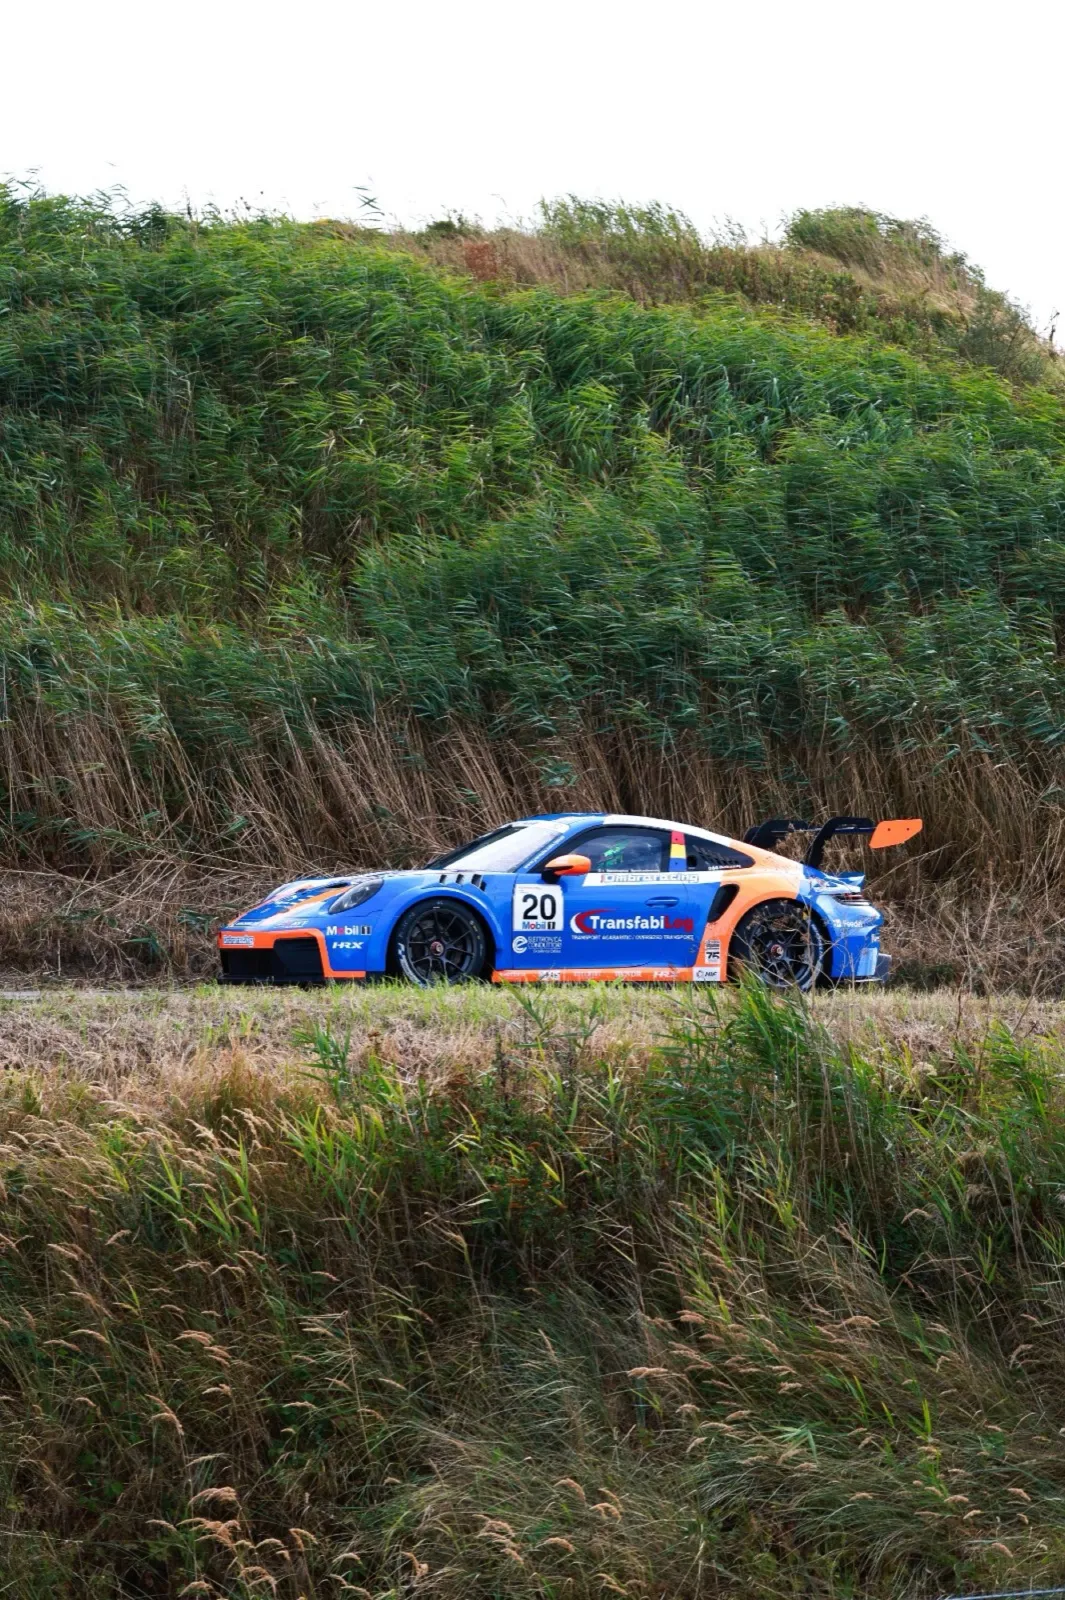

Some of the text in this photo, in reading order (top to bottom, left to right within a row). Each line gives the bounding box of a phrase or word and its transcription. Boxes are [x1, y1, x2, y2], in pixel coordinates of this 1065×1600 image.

[522, 894, 556, 920] 20
[522, 921, 556, 930] Mobil 1
[589, 915, 694, 932] TransfabiLog
[326, 925, 359, 936] Mobil
[706, 951, 720, 959] 75
